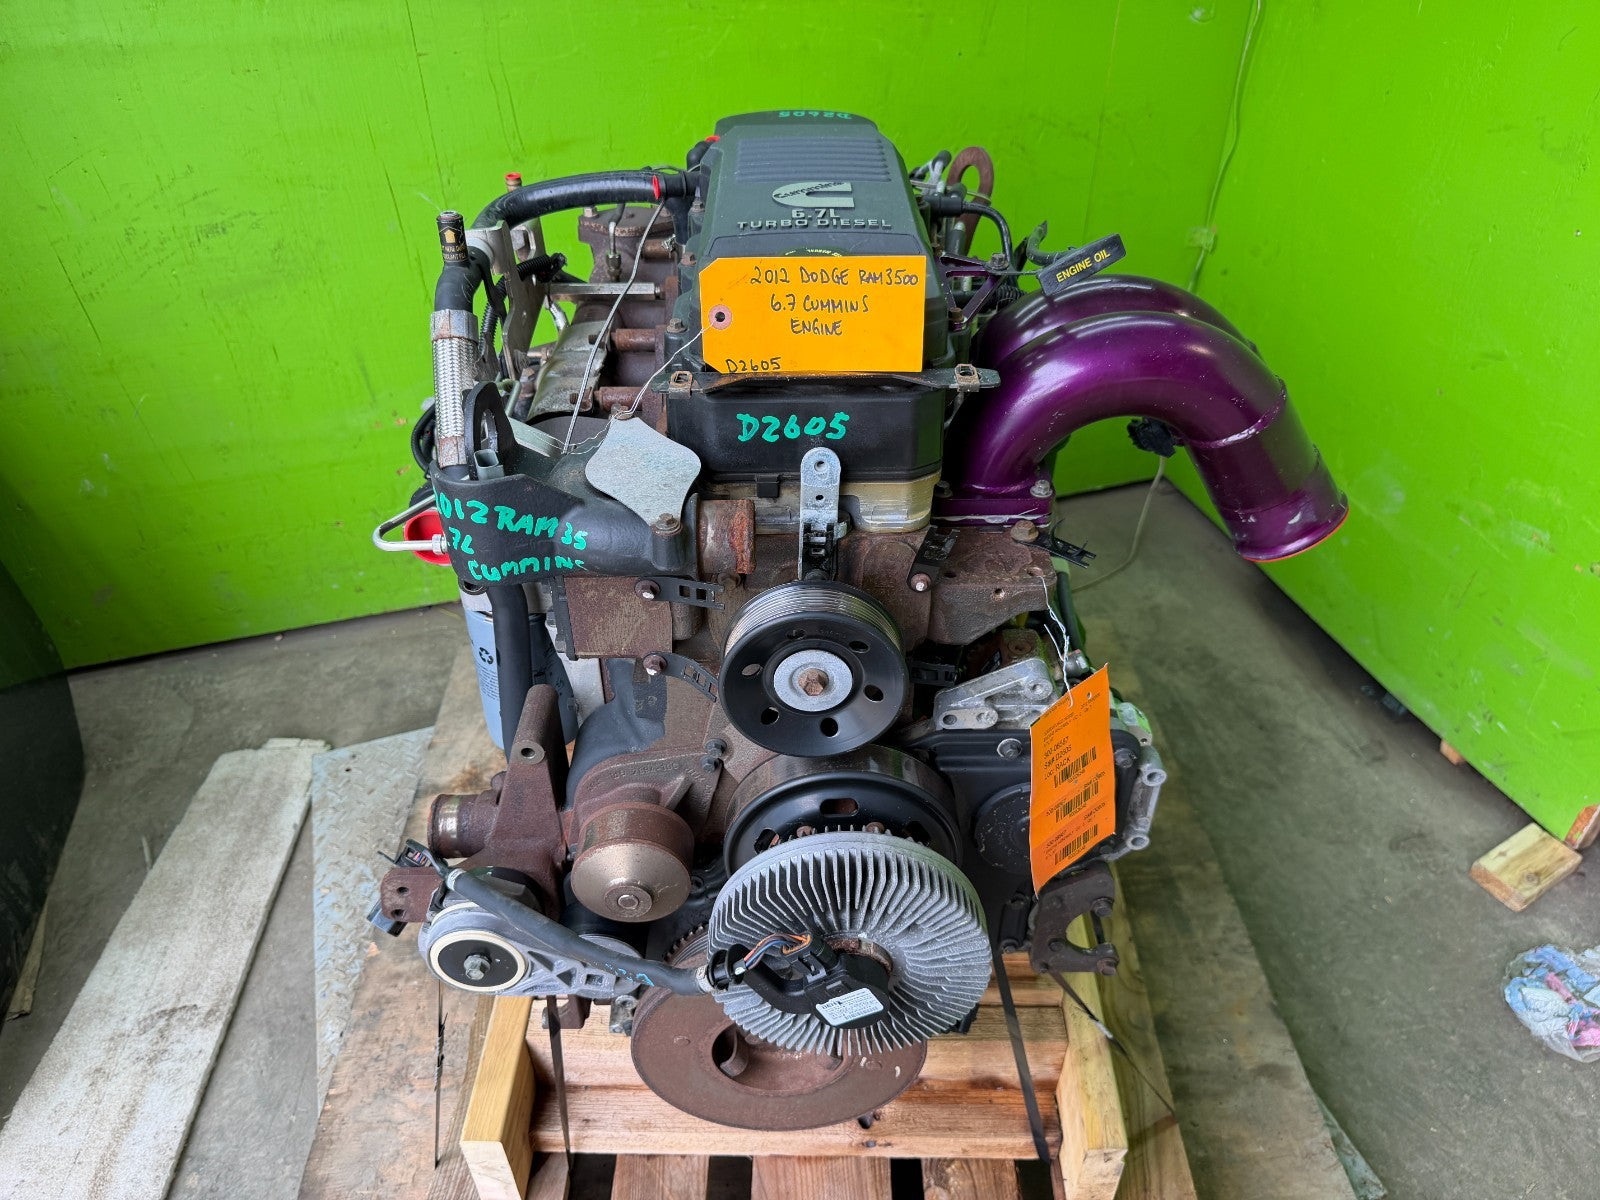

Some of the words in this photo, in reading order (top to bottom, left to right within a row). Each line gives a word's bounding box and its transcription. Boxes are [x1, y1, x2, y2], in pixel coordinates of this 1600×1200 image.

[791, 208, 840, 219] 6.7L
[737, 219, 808, 230] TURBO
[817, 218, 892, 229] DIESEL
[750, 266, 790, 285] 2012
[800, 267, 849, 284] DODGE
[1056, 257, 1092, 282] ENGINE
[1094, 250, 1111, 262] OIL
[770, 293, 796, 312] 6.7
[803, 294, 869, 313] CUMMINS
[790, 317, 843, 336] ENGINE
[725, 356, 782, 373] D2605
[736, 411, 850, 443] D2605
